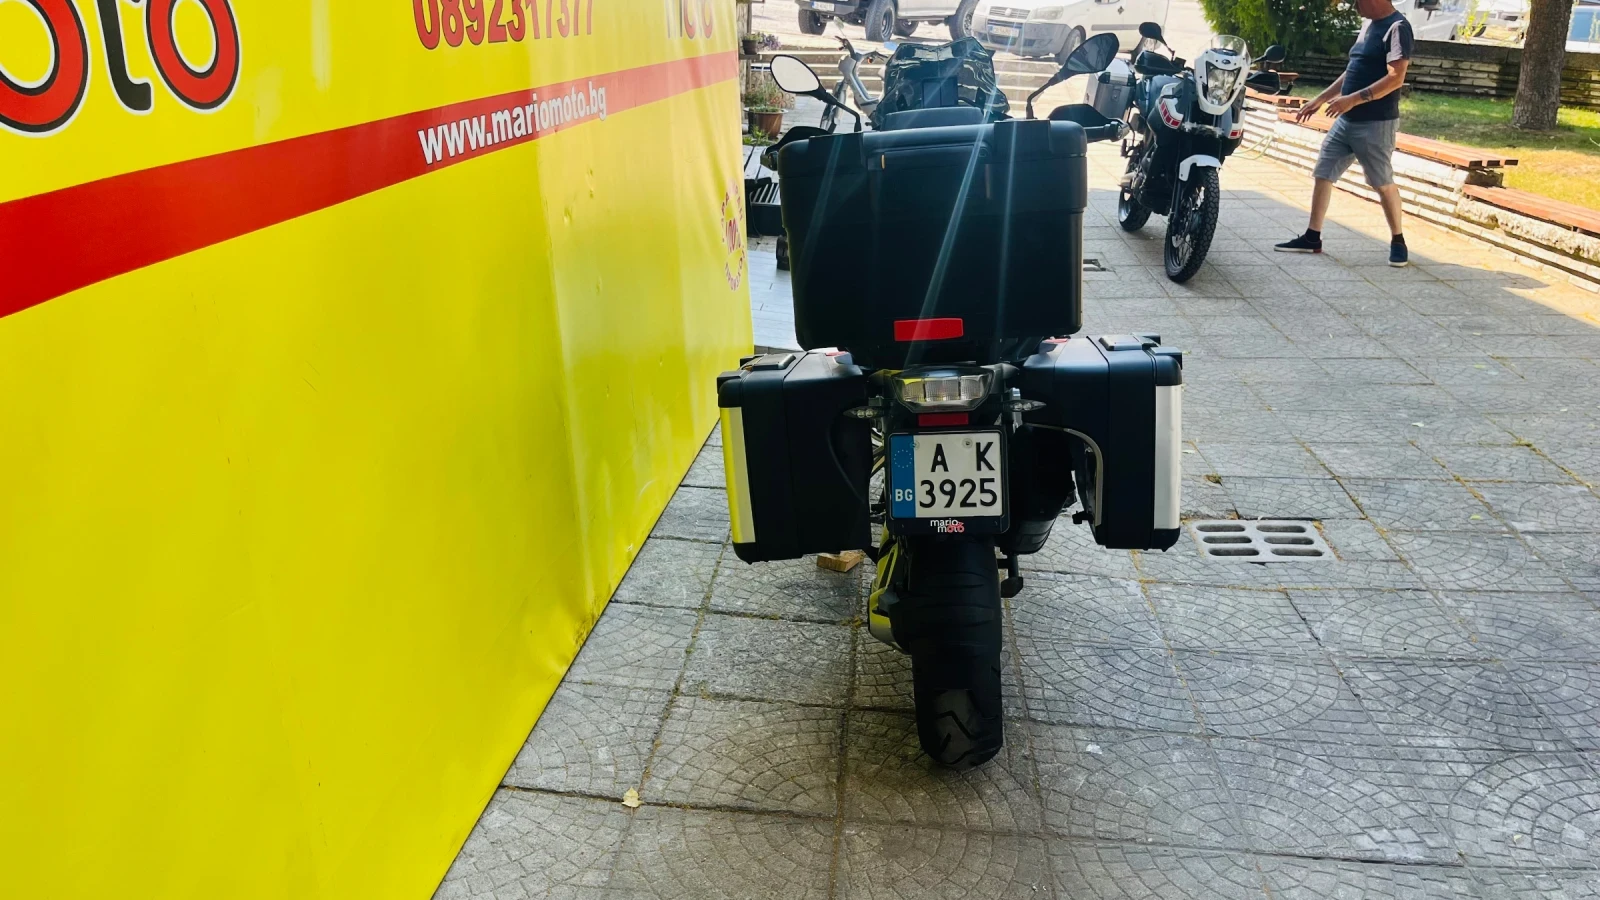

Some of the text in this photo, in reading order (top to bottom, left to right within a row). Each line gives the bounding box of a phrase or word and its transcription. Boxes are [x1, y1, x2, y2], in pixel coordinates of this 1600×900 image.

[417, 80, 607, 165] www.mariomoto.bg
[930, 441, 995, 472] A K
[895, 489, 913, 501] BG
[919, 478, 997, 508] 3925
[930, 517, 959, 527] mario
[937, 522, 965, 533] moto
